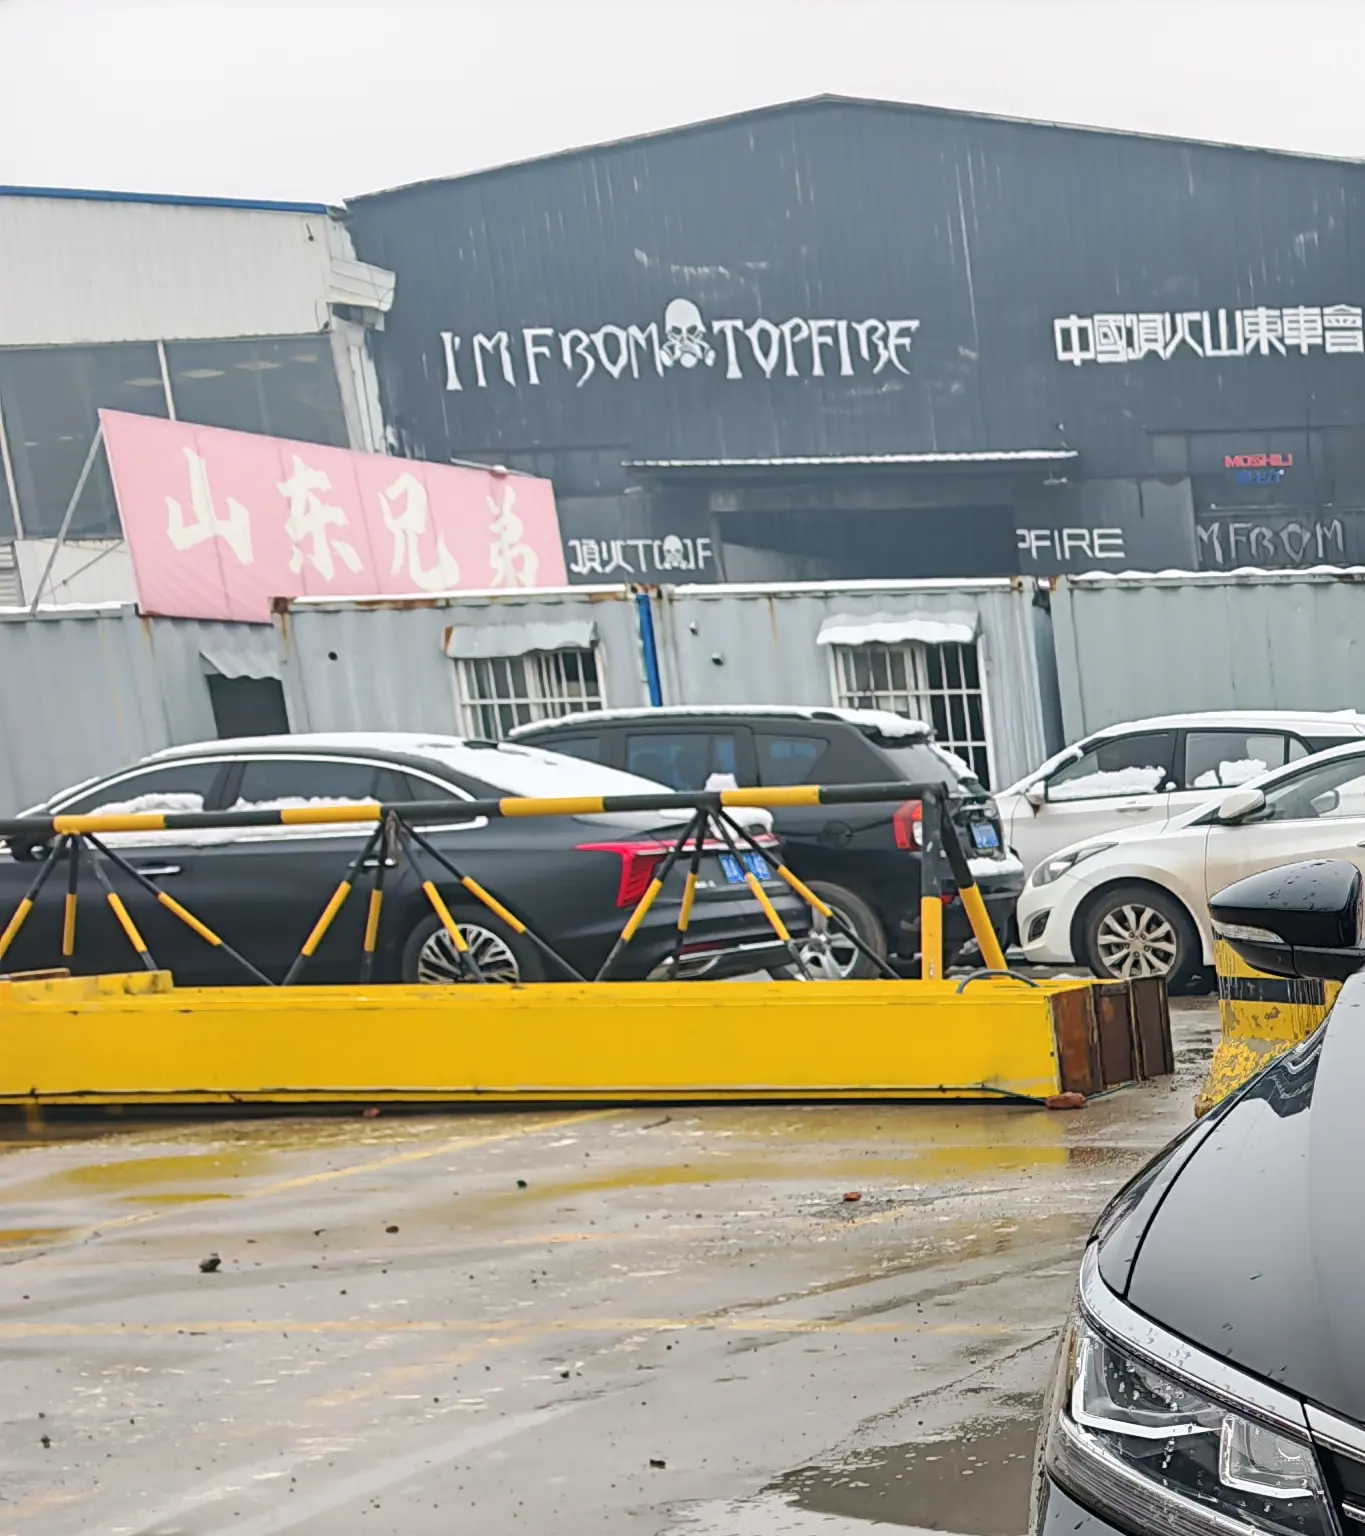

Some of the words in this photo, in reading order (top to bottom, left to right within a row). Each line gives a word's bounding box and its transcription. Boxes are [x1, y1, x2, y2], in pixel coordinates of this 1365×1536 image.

[522, 322, 664, 388] FROM
[712, 317, 920, 379] TOPFIRE
[165, 447, 540, 592] 山东兄弟
